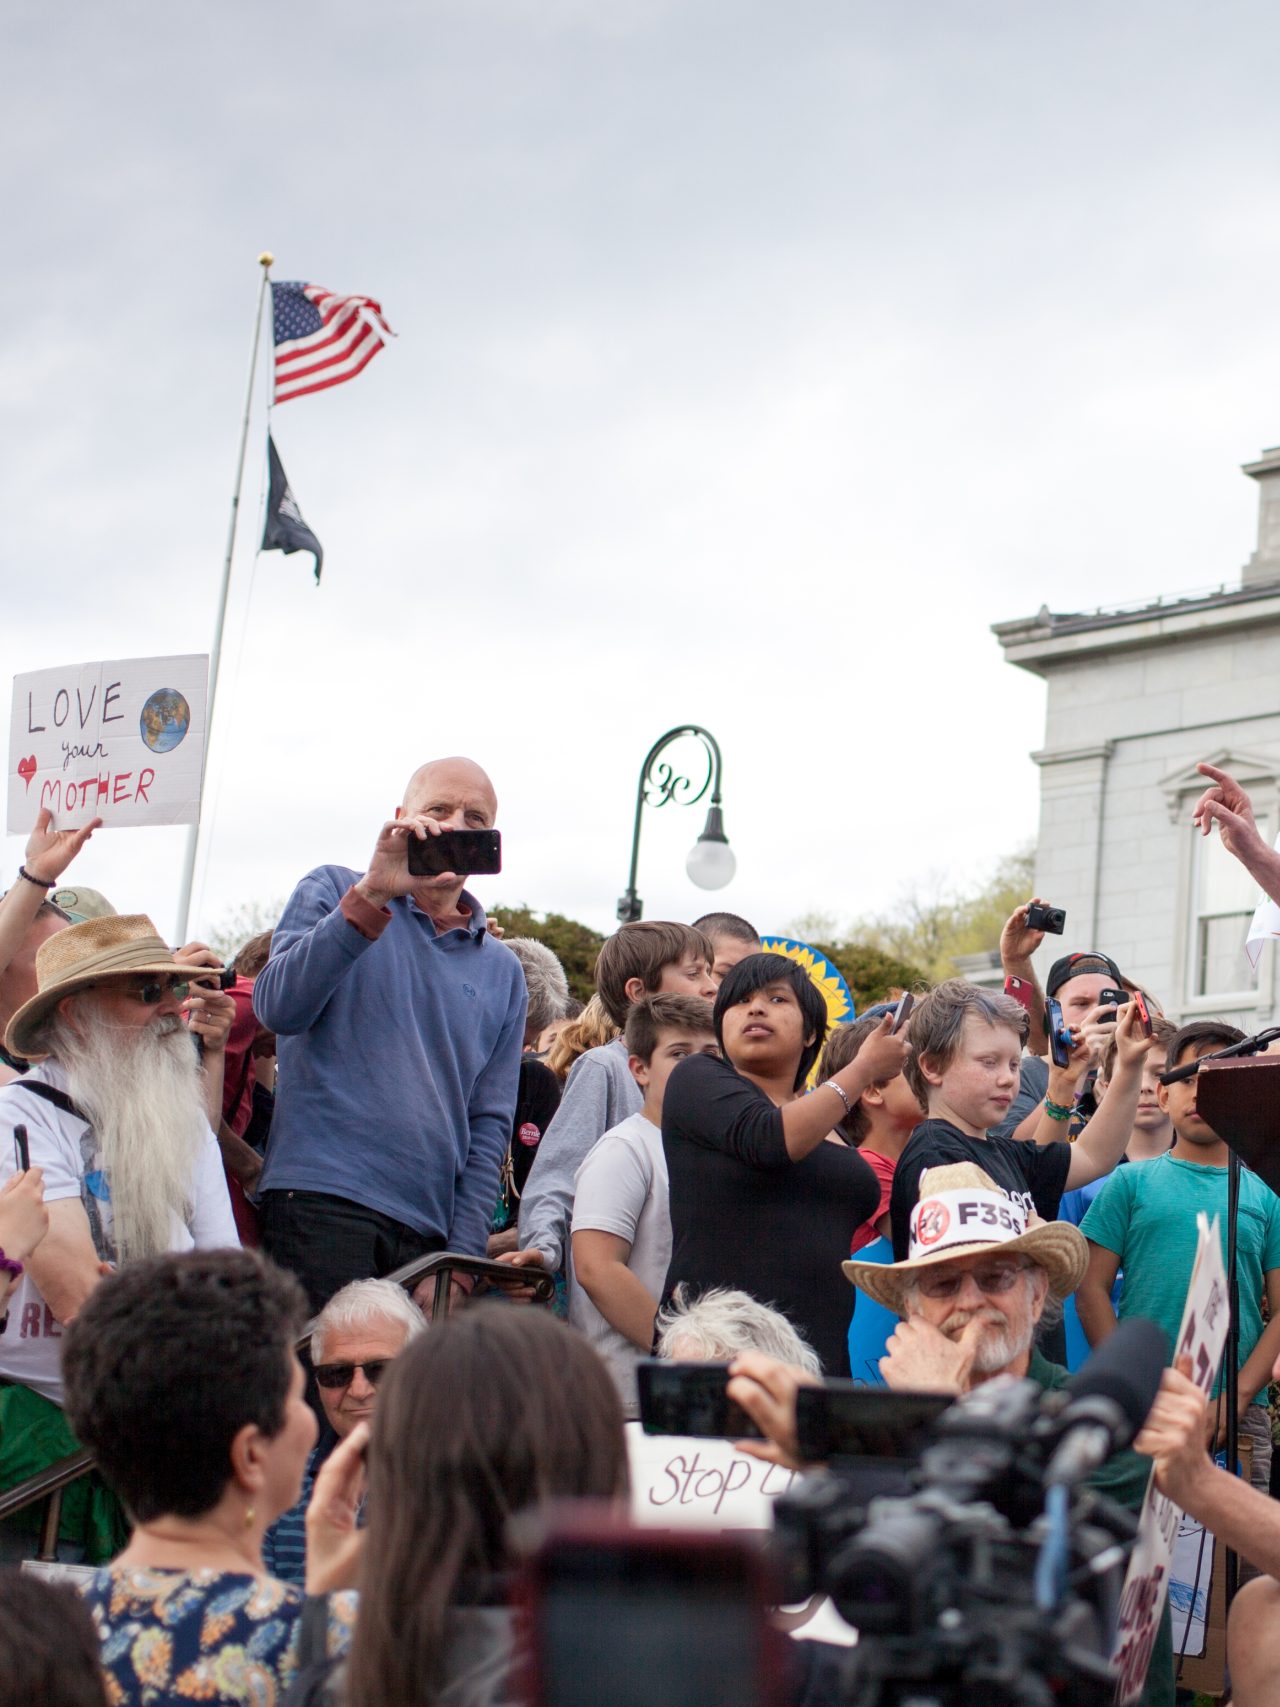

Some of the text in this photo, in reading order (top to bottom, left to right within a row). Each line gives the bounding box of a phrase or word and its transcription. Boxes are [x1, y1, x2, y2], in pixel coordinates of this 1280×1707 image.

[28, 682, 125, 734] LOVE
[61, 740, 109, 771] your
[40, 768, 155, 814] MOTHER
[649, 1452, 751, 1515] Stop
